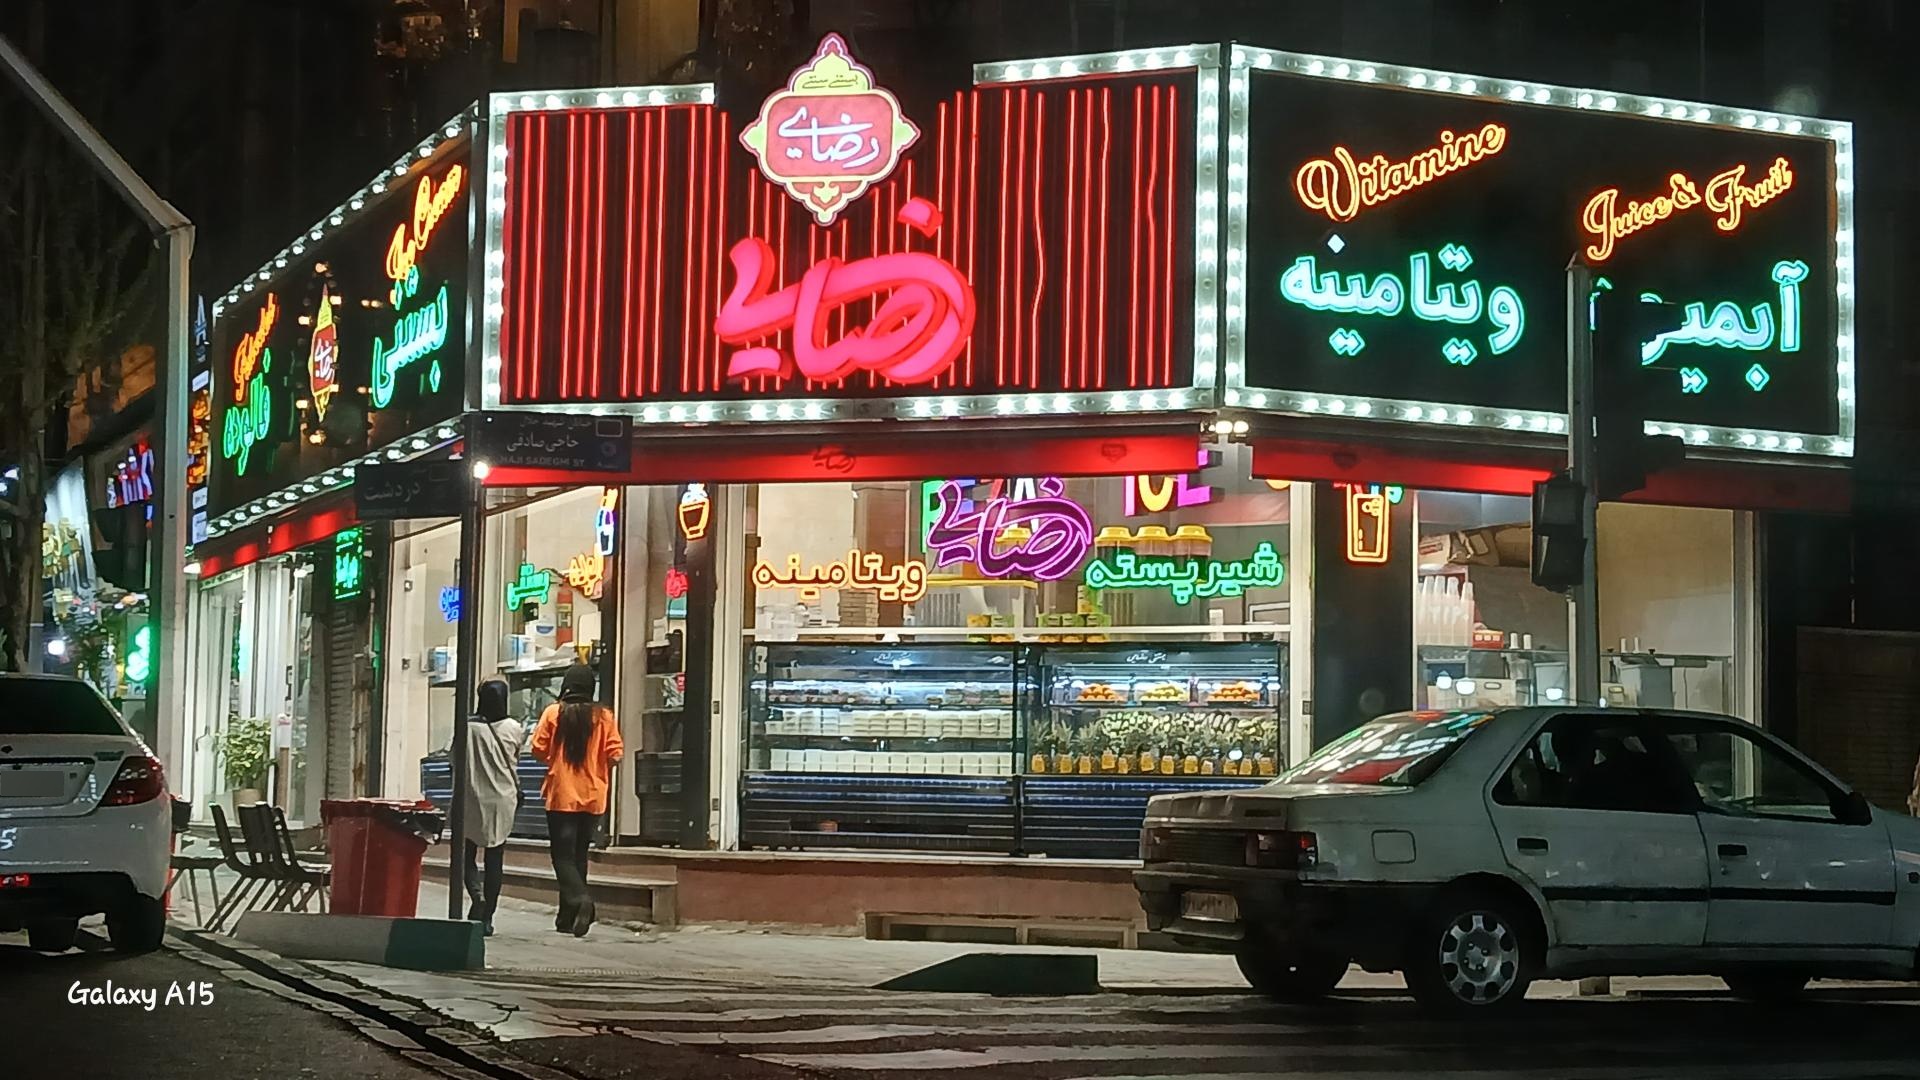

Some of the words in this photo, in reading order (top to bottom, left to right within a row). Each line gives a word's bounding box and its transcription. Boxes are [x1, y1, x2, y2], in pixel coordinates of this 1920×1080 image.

[777, 106, 880, 169] رضایی
[1296, 124, 1506, 222] Vitamine
[1583, 189, 1673, 260] Juice
[1669, 173, 1701, 209] &
[1705, 157, 1792, 231] Fruit
[372, 264, 448, 408] بستنی
[714, 197, 976, 383] رضایی
[1280, 233, 1525, 365] ویتامینه
[223, 347, 271, 476] فالوده
[751, 548, 928, 603] ویتامینه
